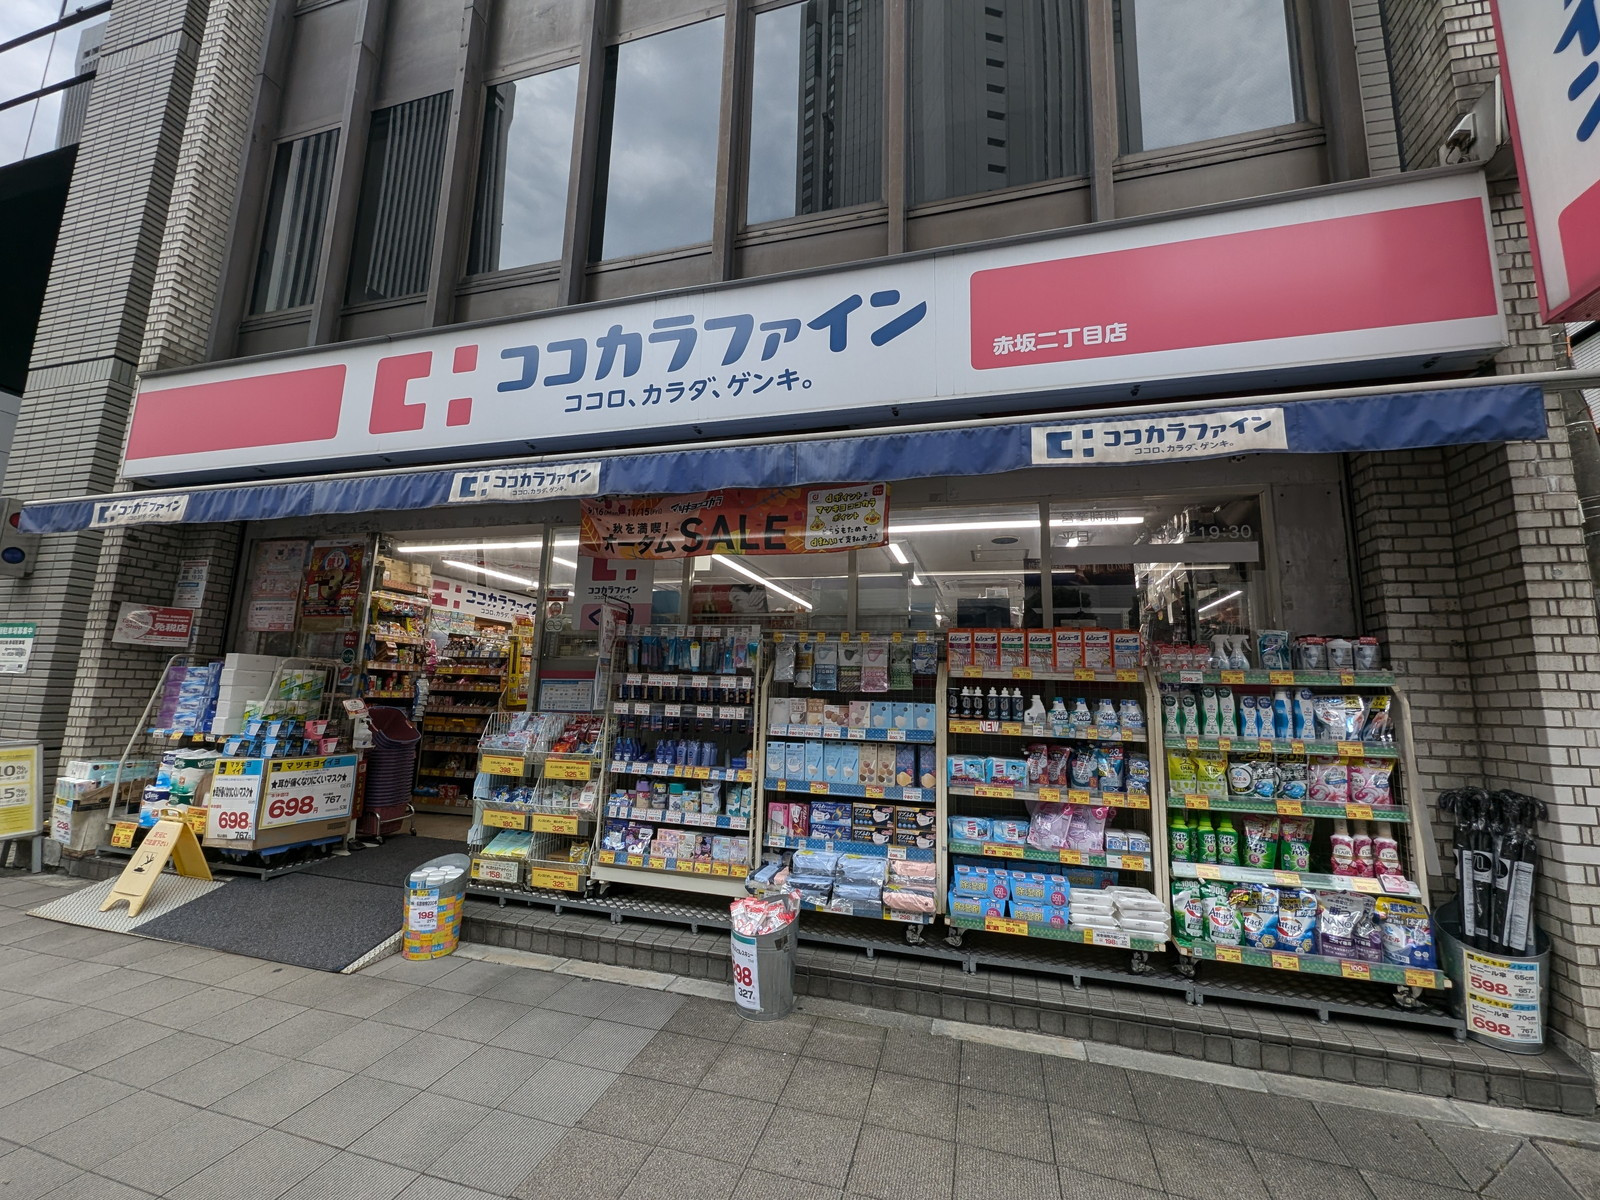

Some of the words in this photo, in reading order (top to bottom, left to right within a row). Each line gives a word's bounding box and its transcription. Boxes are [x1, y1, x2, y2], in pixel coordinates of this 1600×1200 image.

[497, 289, 927, 392] ココカラファイン
[993, 323, 1128, 355] 赤坂二丁目店
[564, 371, 813, 413] ココロ、カラダ、ゲンキ。
[1103, 416, 1273, 448] ココカラファイン
[1134, 442, 1235, 456] ココロ、カラダ、ゲンキ。
[492, 468, 593, 489] ココカラファイン
[681, 514, 788, 553] SALE
[602, 533, 677, 554] オータム
[154, 622, 188, 633] 免税店
[979, 720, 1000, 732] NEW
[286, 758, 341, 769] マツキヨイイヨ
[1184, 900, 1203, 912] Atta
[1389, 902, 1418, 914] 超特大
[418, 911, 434, 920] 198
[1209, 907, 1234, 921] Attack
[1104, 938, 1116, 946] 198
[733, 962, 752, 987] 98
[1469, 963, 1507, 978] ビニール傘
[738, 986, 754, 1000] 327
[1472, 1003, 1510, 1019] ビニール傘
